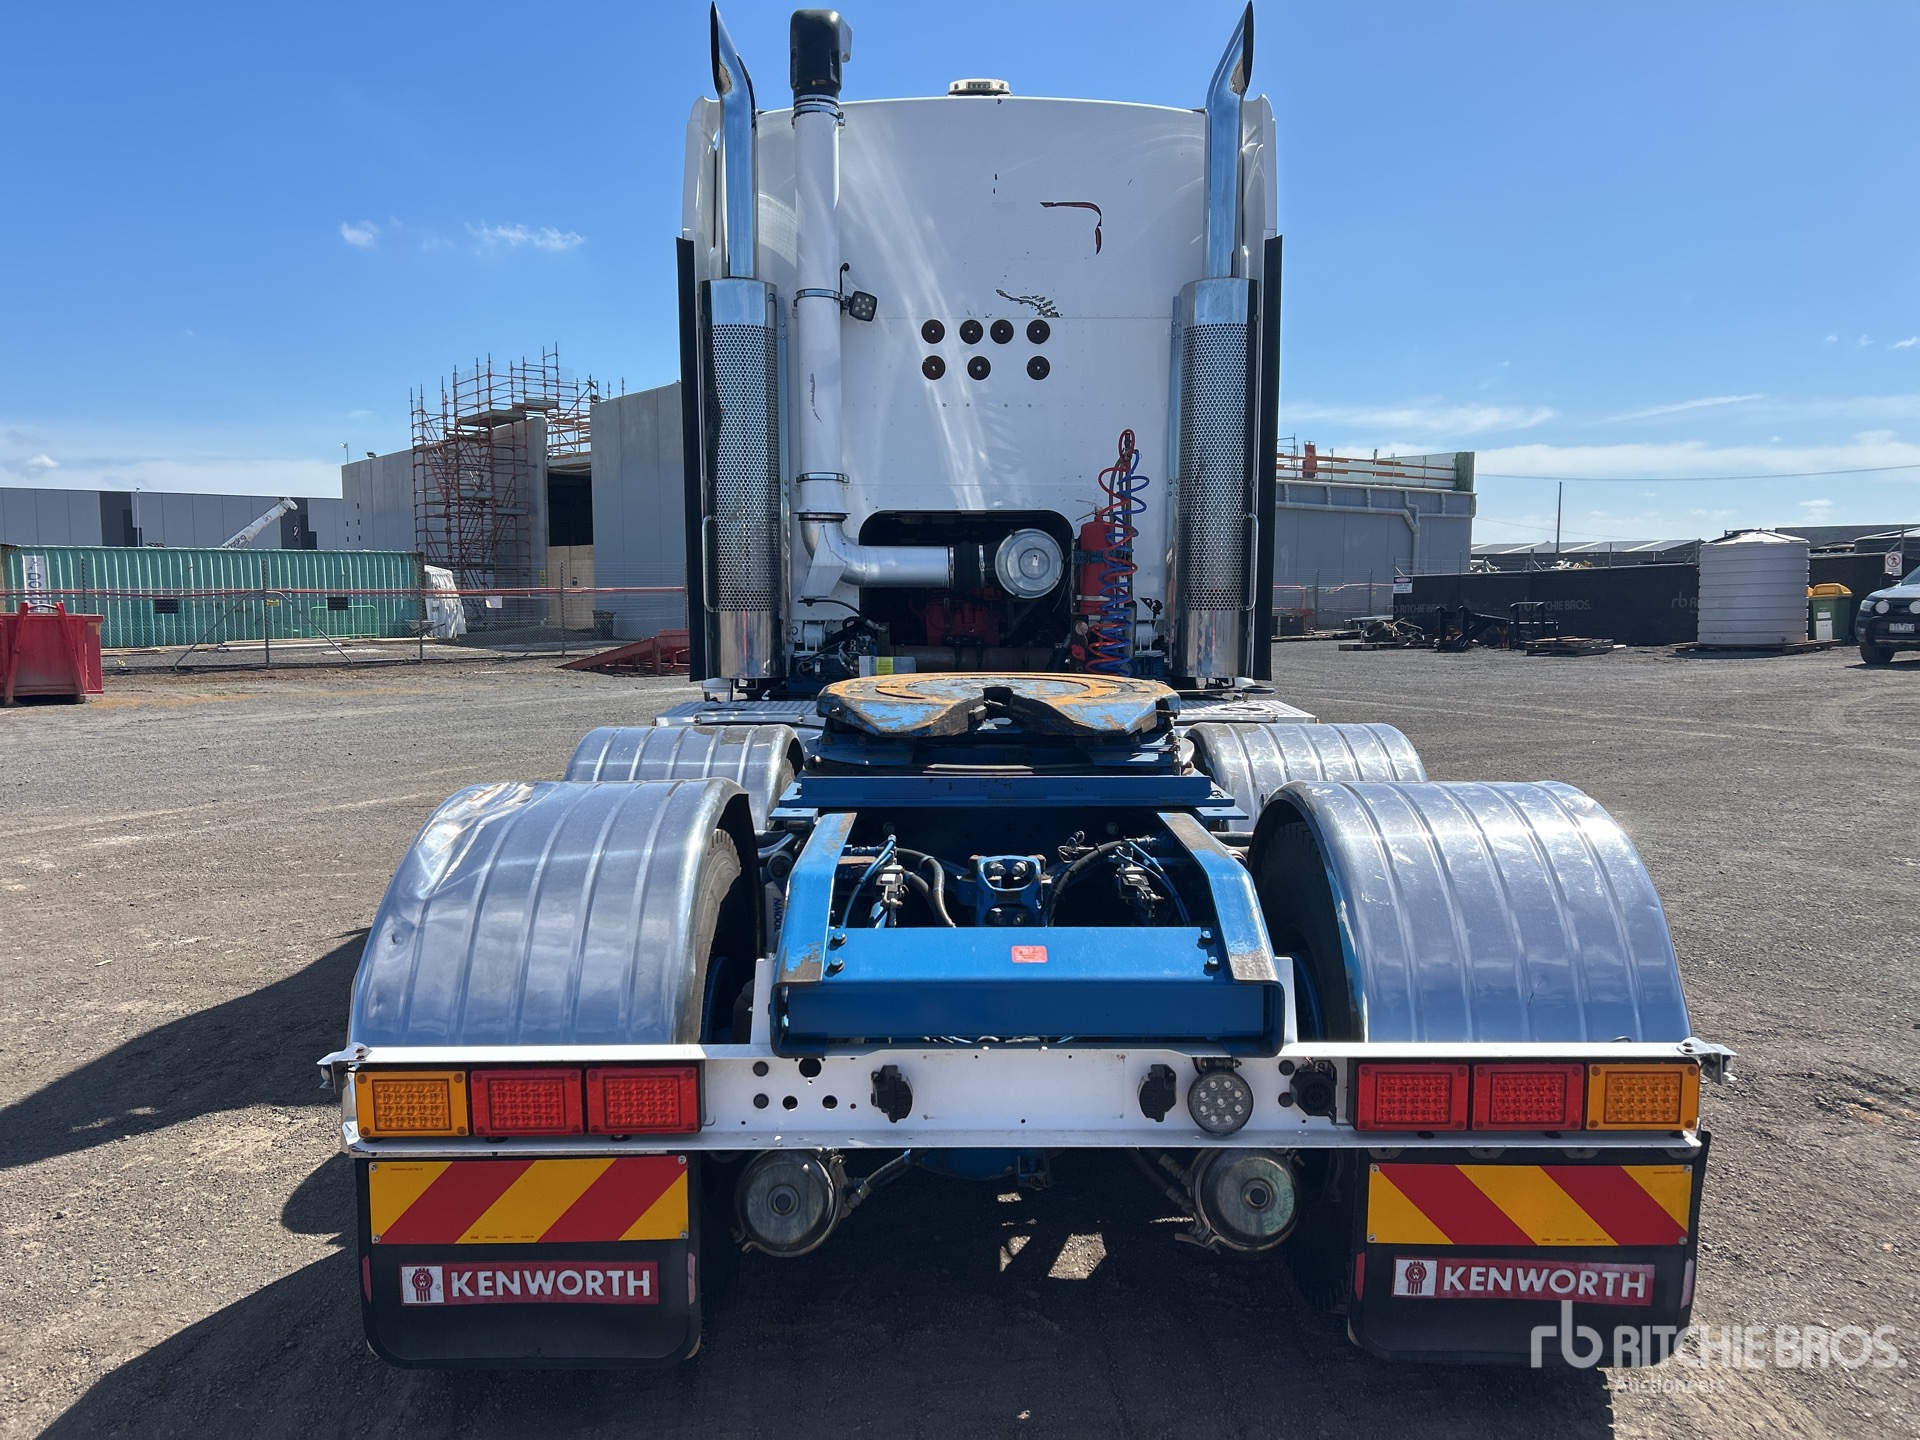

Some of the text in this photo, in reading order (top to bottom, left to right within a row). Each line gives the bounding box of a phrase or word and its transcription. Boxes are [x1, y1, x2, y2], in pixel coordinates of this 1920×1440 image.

[1535, 600, 1564, 611] CHIE
[1564, 599, 1592, 611] BROS.
[450, 1269, 651, 1298] KENWORTH
[1442, 1266, 1646, 1299] KENWORTH
